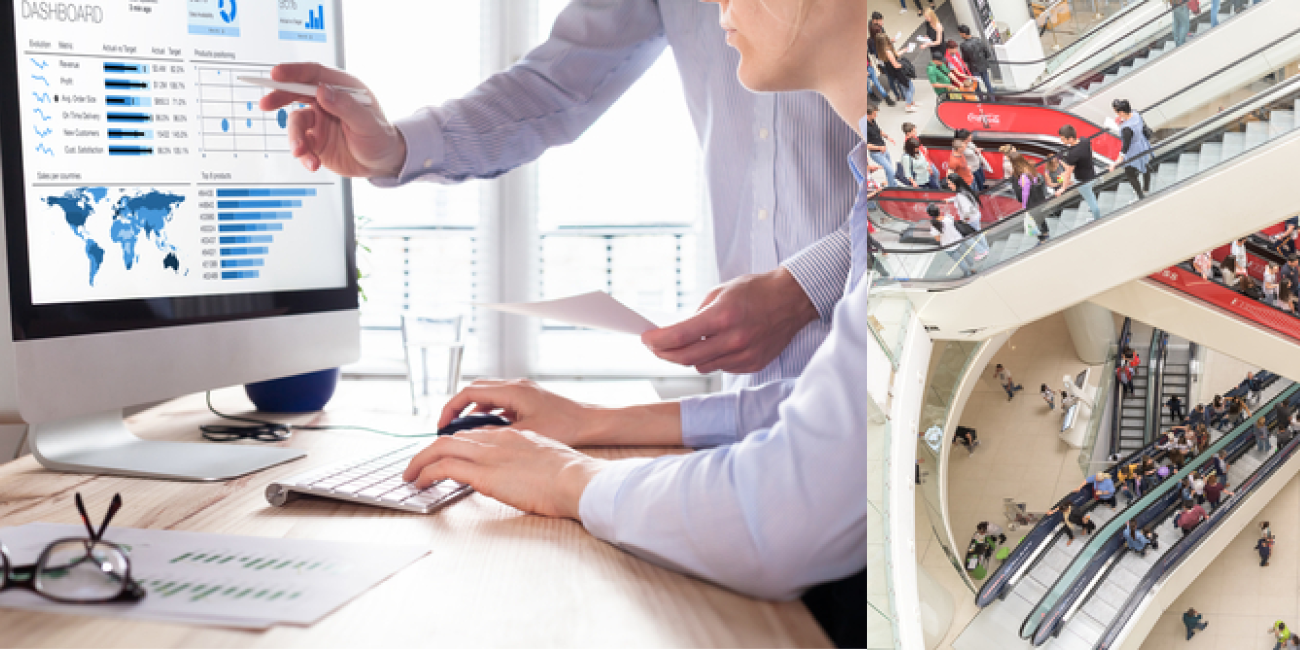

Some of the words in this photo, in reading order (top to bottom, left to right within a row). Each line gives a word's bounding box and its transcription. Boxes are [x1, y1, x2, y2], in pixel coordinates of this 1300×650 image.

[21, 0, 103, 23] DASHBOARD
[29, 39, 51, 48] Evolution
[123, 44, 137, 54] Target
[152, 47, 165, 55] Actual
[168, 47, 181, 56] Target
[59, 59, 80, 69] Revenue
[60, 77, 73, 85] Profit
